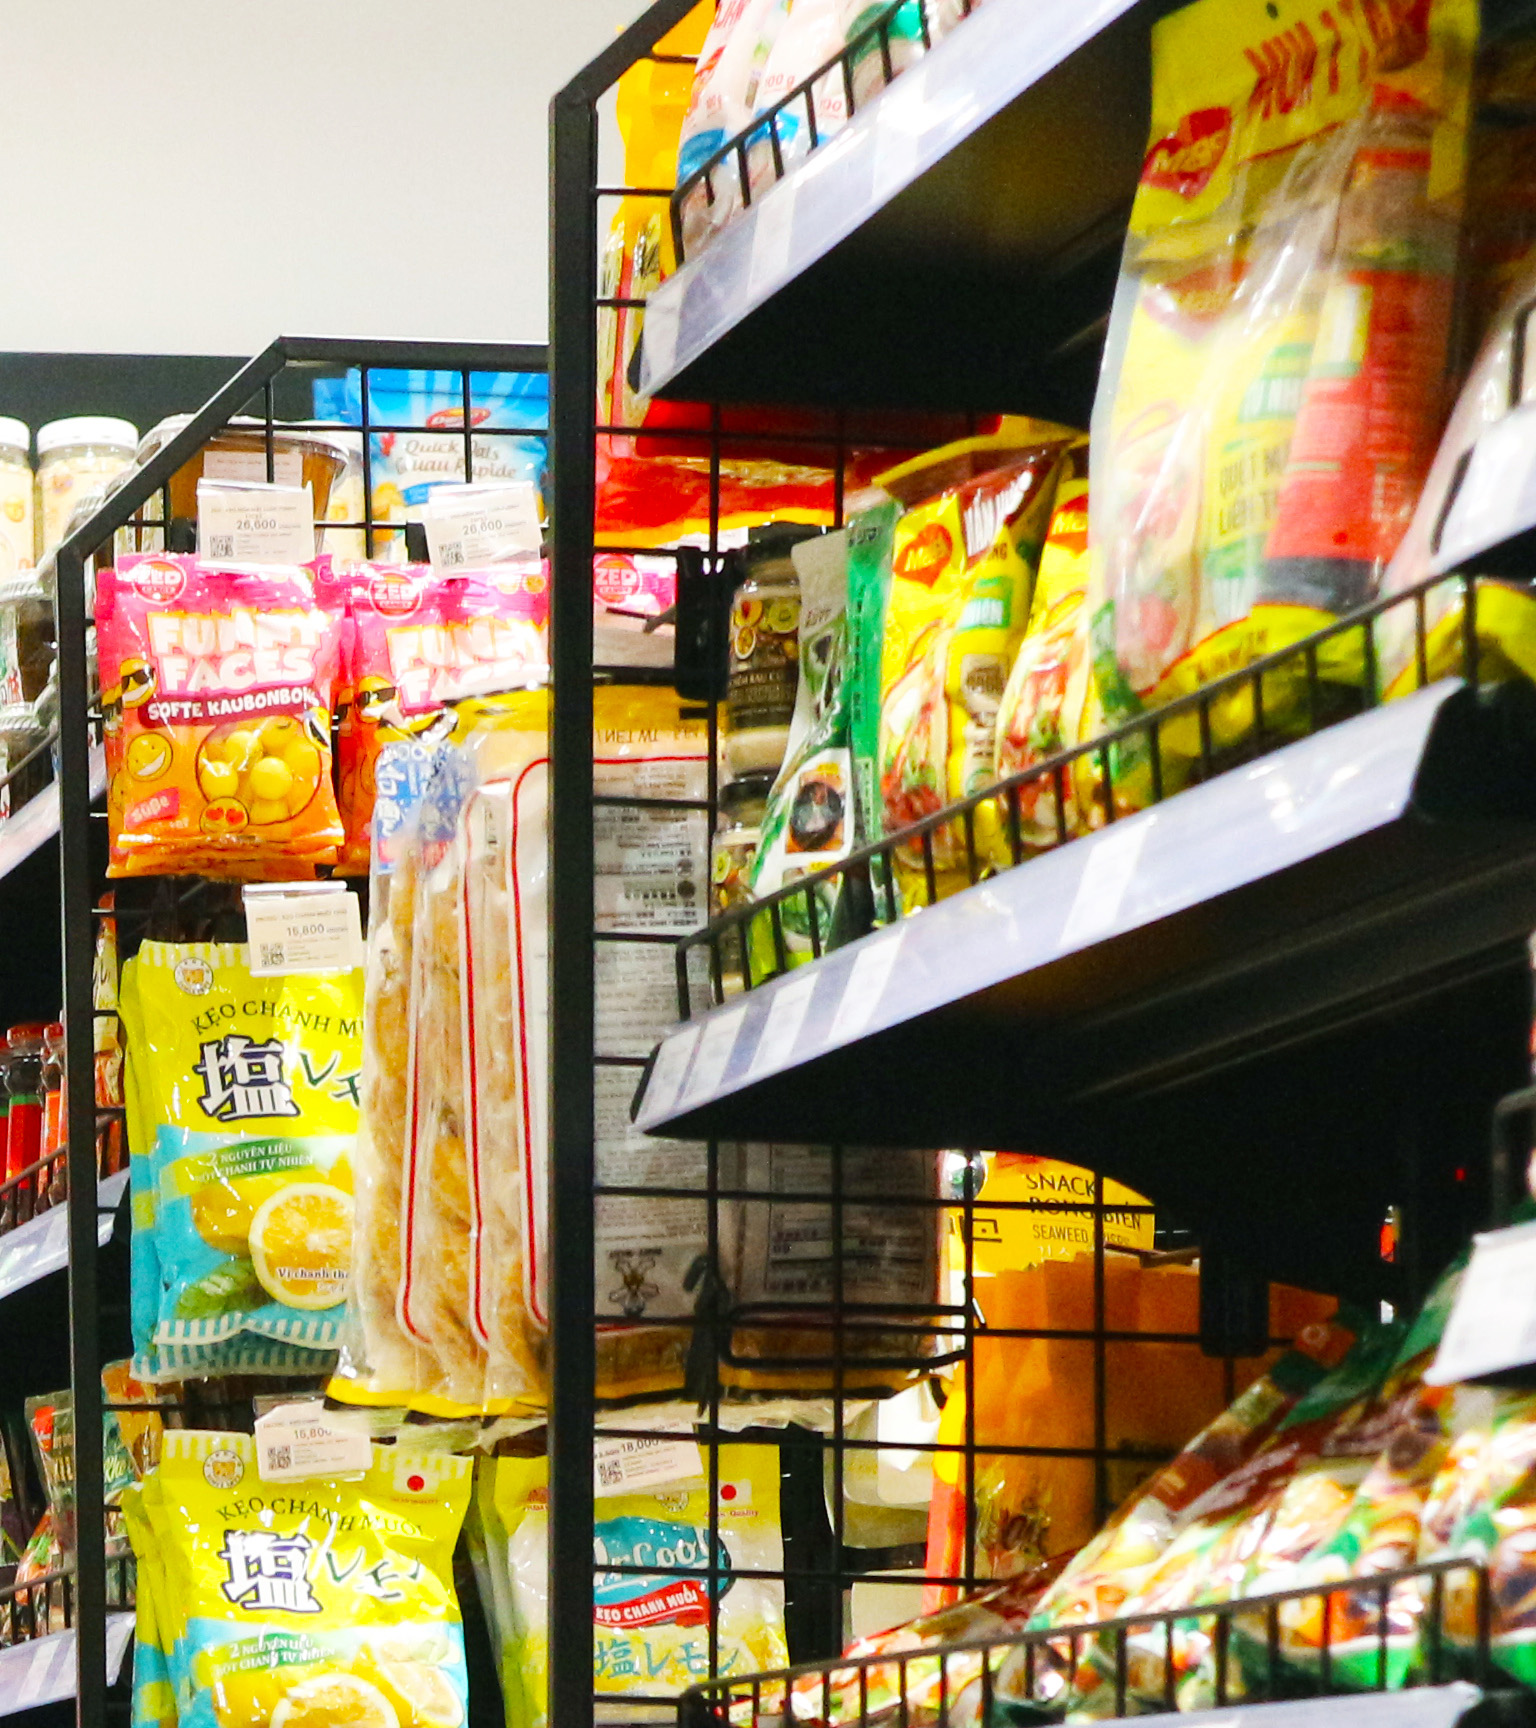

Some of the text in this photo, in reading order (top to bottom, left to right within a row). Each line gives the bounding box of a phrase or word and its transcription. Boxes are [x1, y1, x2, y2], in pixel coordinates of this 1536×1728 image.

[406, 438, 459, 456] Quick
[452, 457, 518, 479] Rpide
[236, 519, 277, 532] 26,600
[594, 566, 635, 588] ZED
[162, 648, 315, 692] FACES
[147, 700, 203, 721] SOFTE
[190, 999, 330, 1036] KẸO CHANH
[1025, 1173, 1096, 1196] SNACK
[1032, 1223, 1089, 1243] SEAWEED
[217, 1497, 264, 1521] KẸO
[595, 1604, 621, 1624] KẸO
[624, 1595, 667, 1620] CHANH
